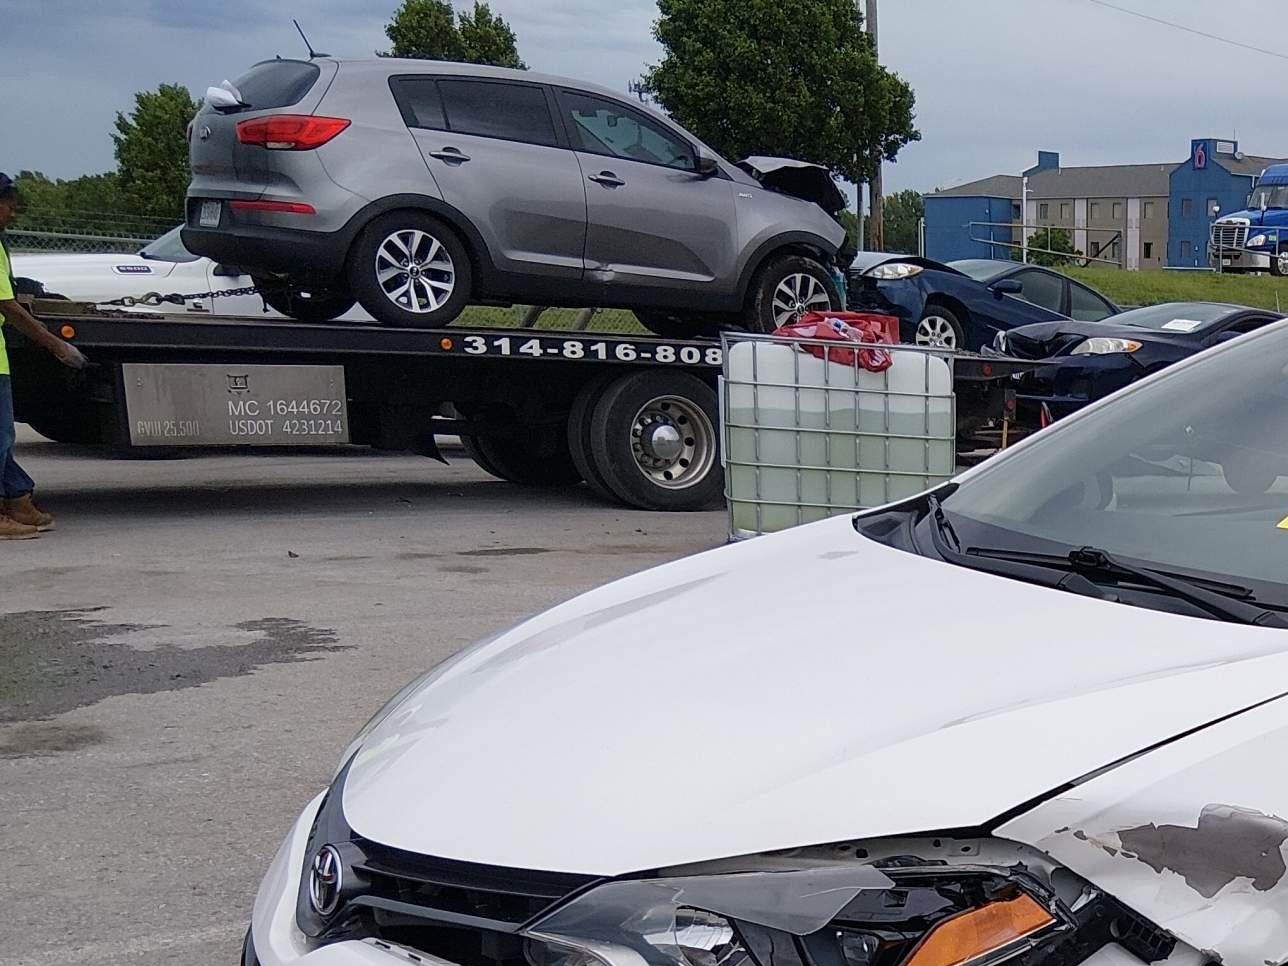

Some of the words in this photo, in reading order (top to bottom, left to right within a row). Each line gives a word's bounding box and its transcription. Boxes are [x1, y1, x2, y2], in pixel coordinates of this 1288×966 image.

[463, 336, 723, 365] 314-816-808
[228, 401, 260, 416] MC
[266, 400, 342, 415] 1644672
[229, 420, 273, 435] USDOT
[282, 419, 343, 434] 4231214
